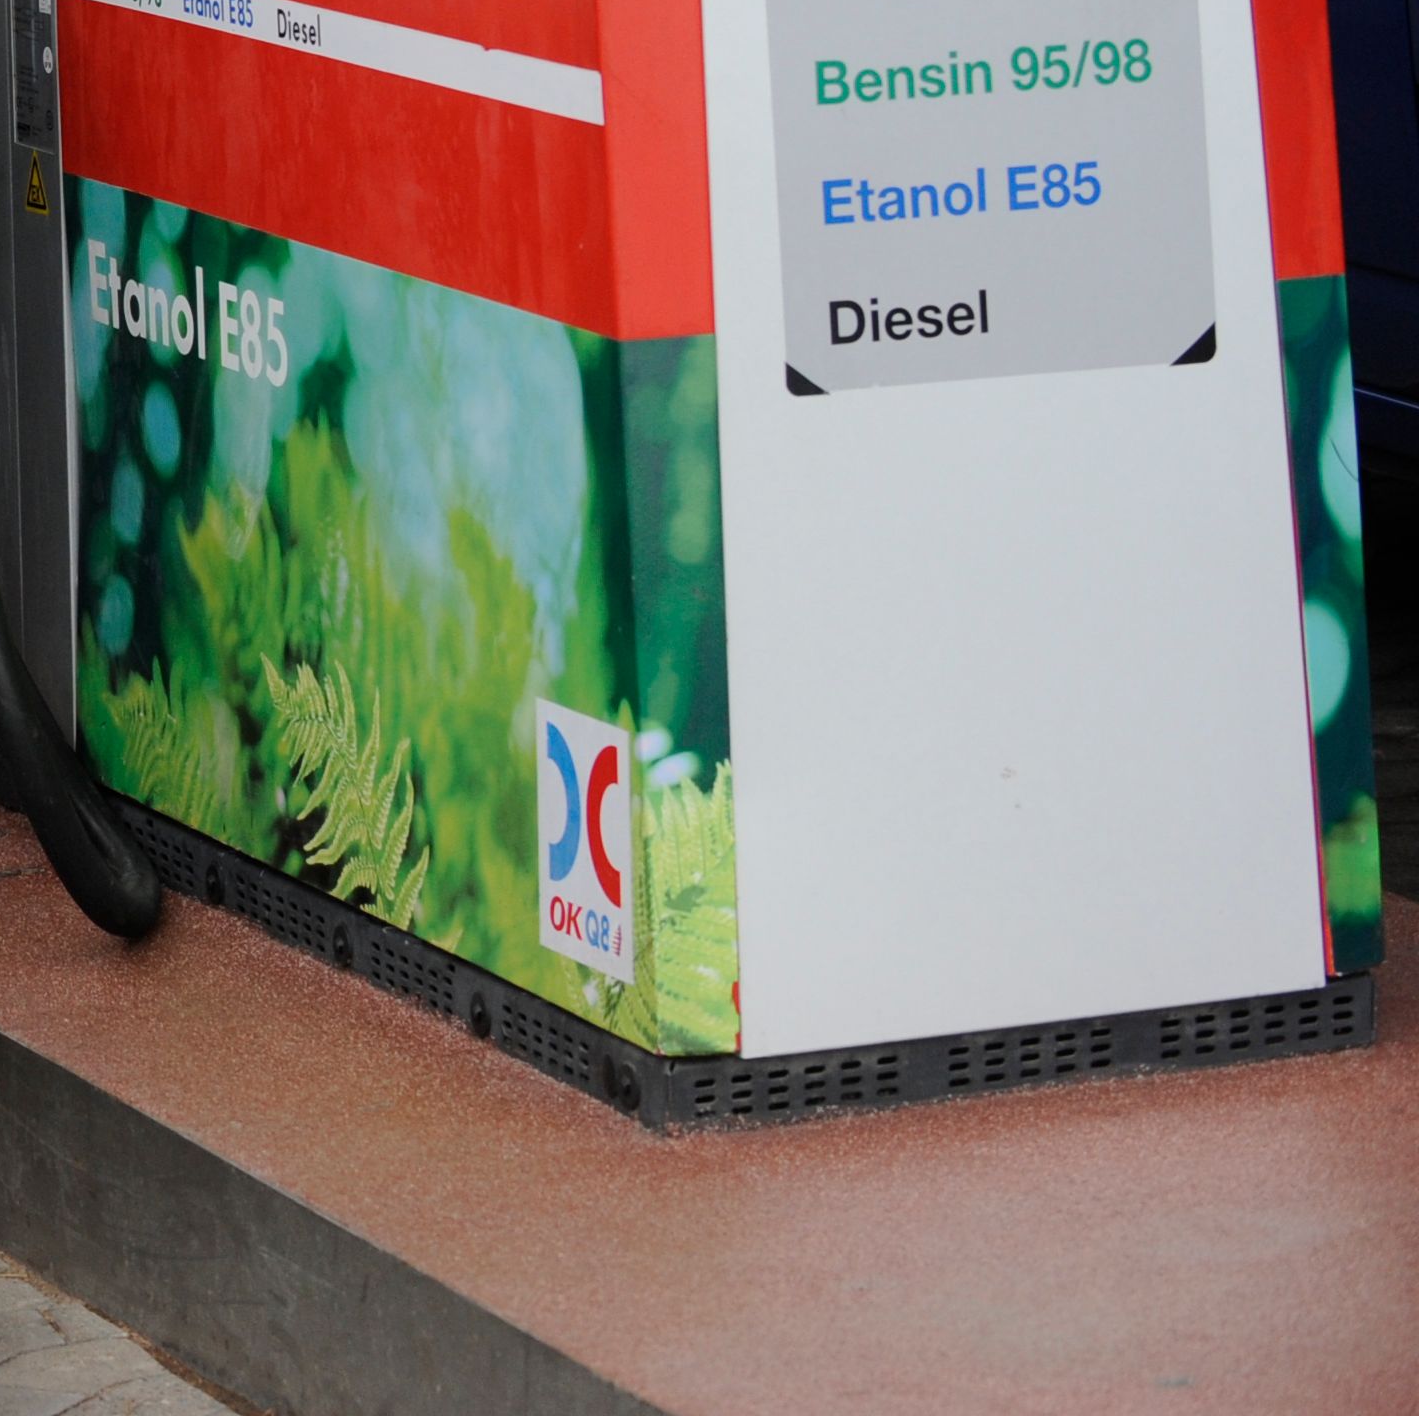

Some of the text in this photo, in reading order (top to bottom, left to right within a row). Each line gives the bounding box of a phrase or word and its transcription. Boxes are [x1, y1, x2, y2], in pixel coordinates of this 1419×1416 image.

[277, 8, 321, 47] Diesel
[814, 38, 1153, 105] Bensin 95/98
[821, 161, 1102, 225] Etanol E85
[87, 239, 289, 387] Etanol E85
[828, 289, 989, 346] Diesel
